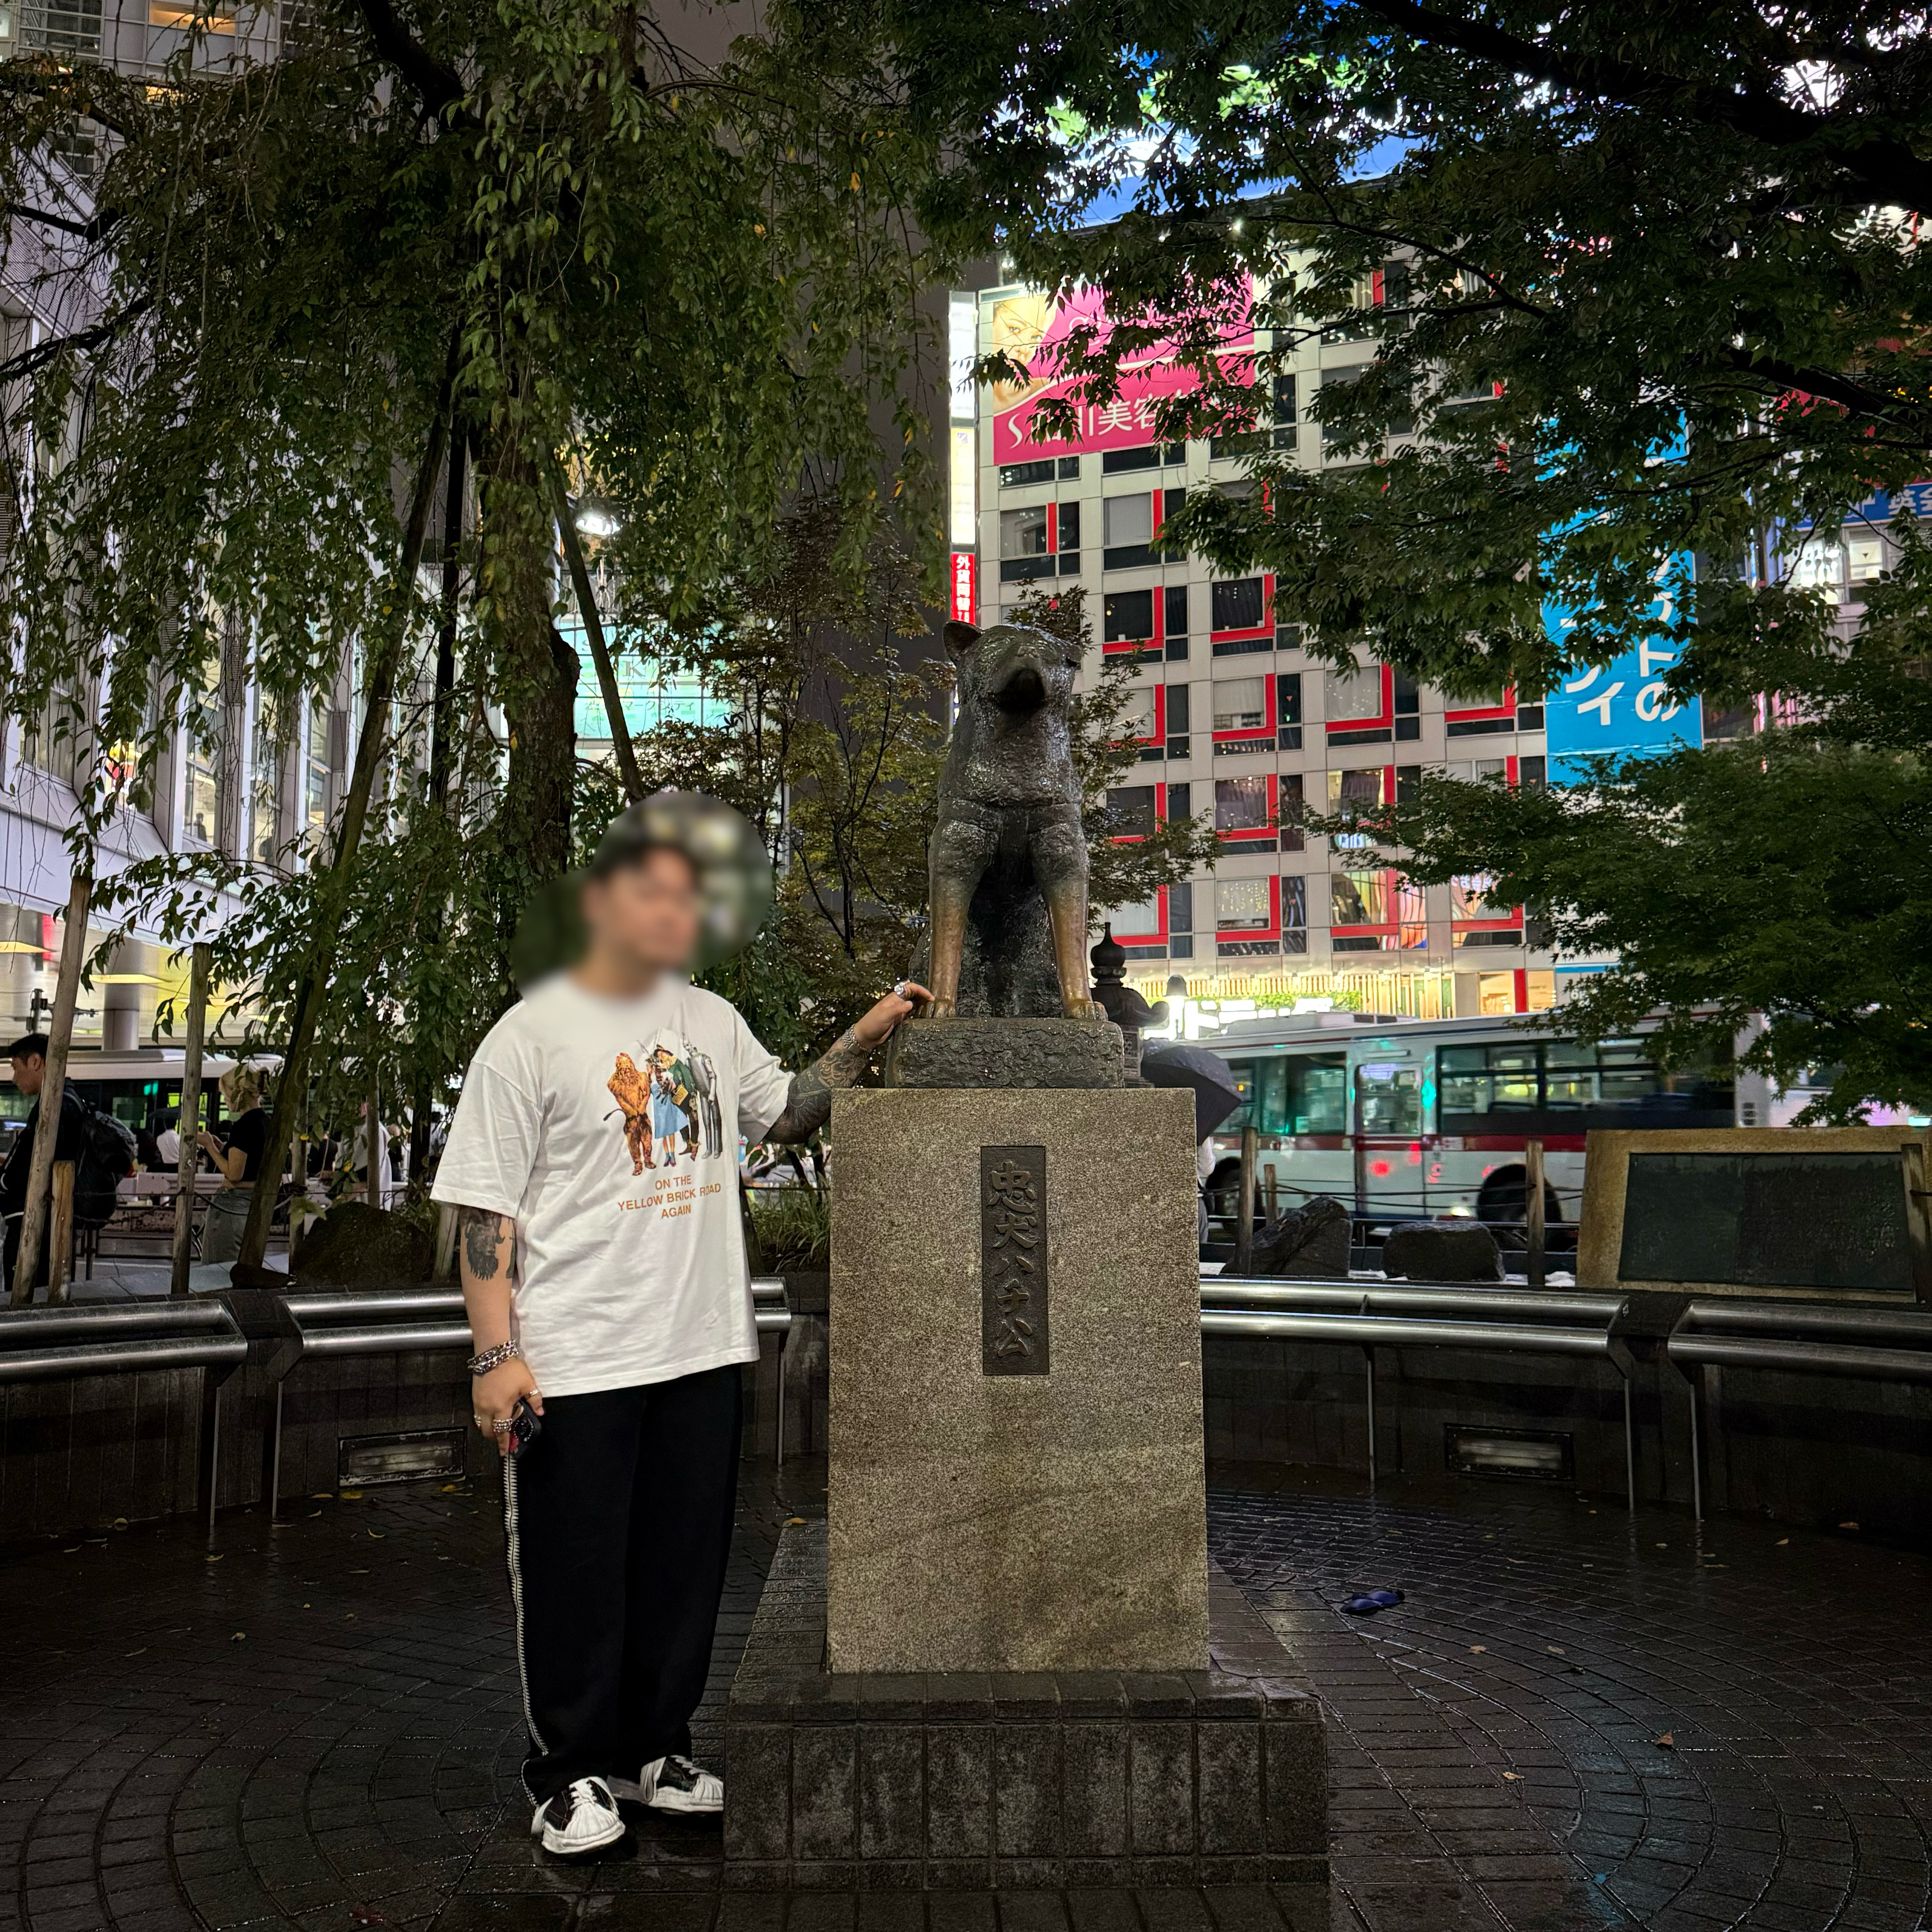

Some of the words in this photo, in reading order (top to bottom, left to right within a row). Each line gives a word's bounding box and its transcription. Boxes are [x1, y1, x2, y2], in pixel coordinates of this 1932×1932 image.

[655, 1179, 670, 1190] ON
[673, 1175, 692, 1186] THE
[618, 1194, 663, 1211] YELLOW
[667, 1189, 696, 1203] BRICK
[700, 1183, 721, 1197] ROAD
[661, 1204, 691, 1219] AGAIN
[987, 1161, 1038, 1358] 忠犬ハチ公
